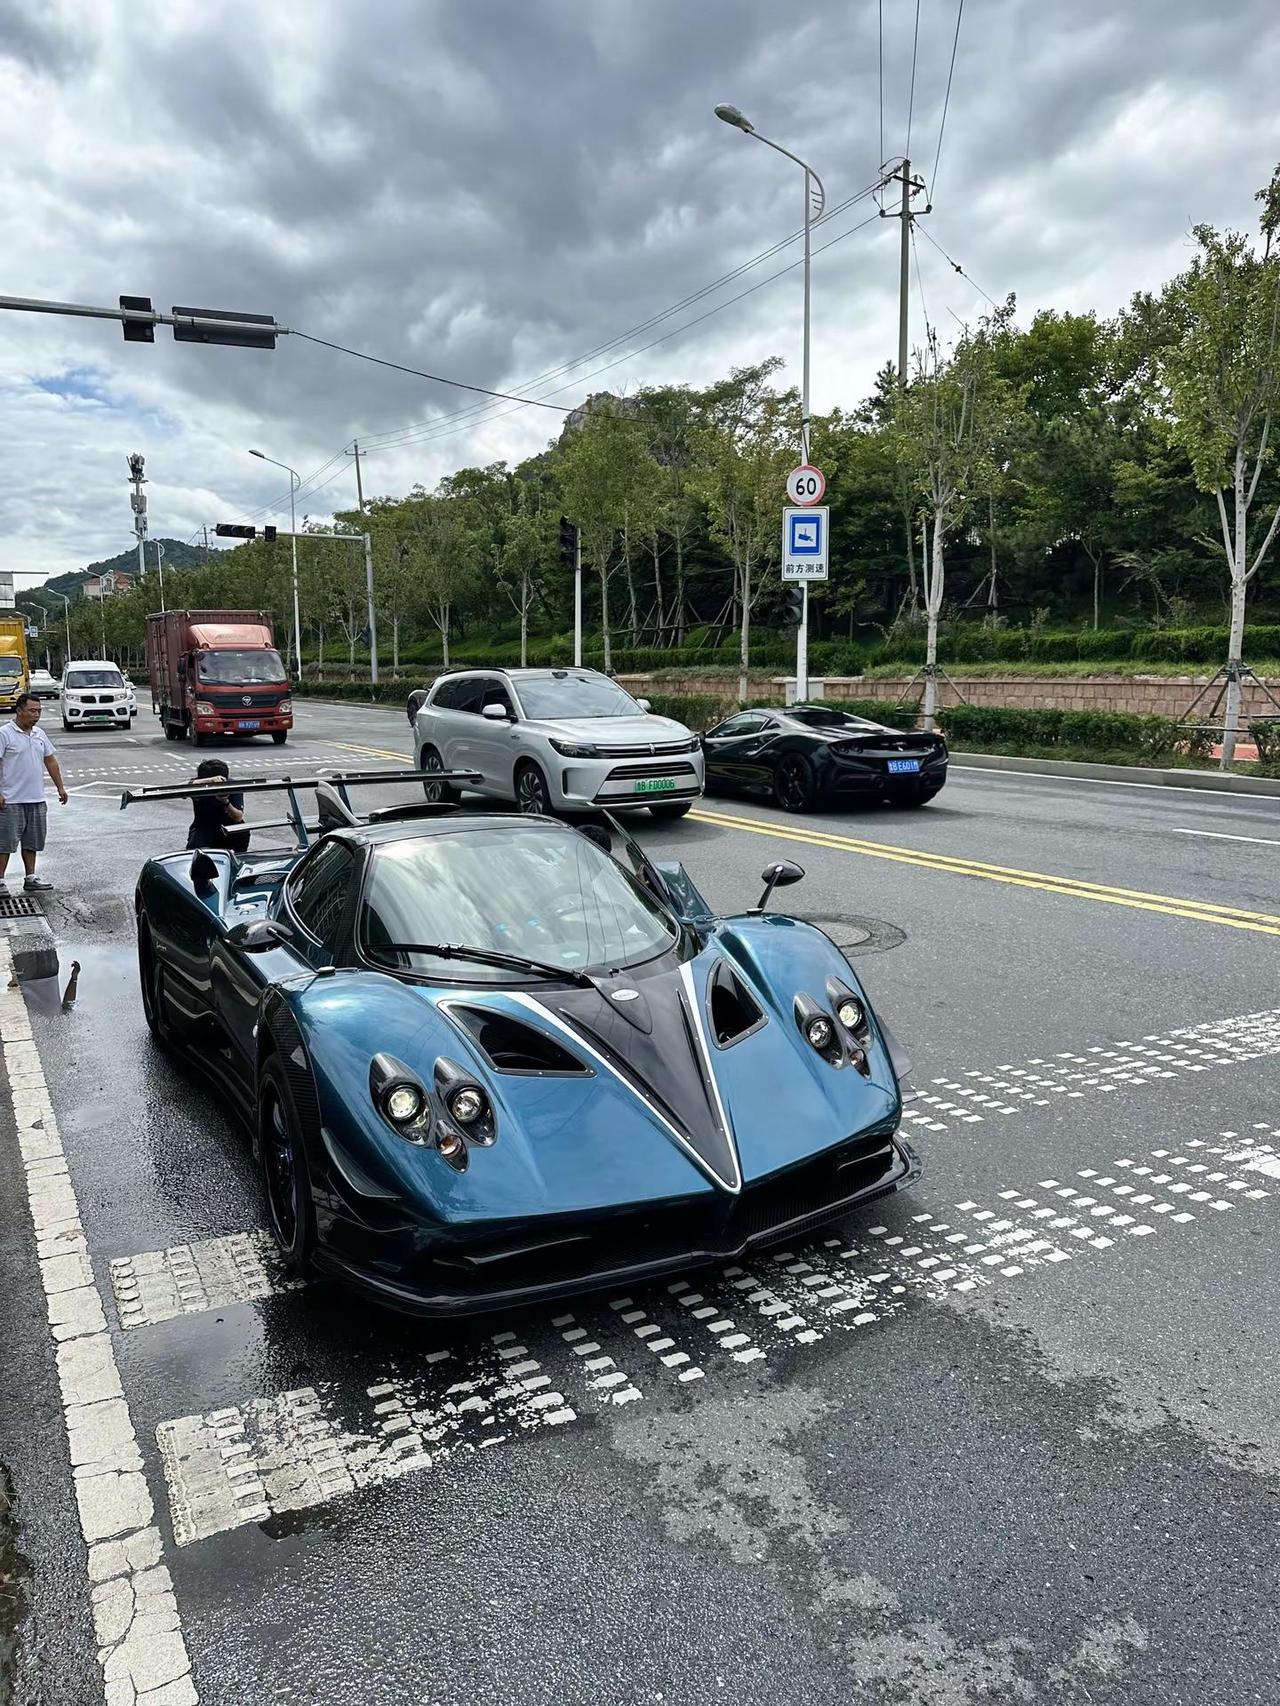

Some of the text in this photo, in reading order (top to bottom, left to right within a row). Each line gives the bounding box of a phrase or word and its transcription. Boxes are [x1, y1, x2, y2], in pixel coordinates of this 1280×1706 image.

[796, 478, 817, 495] 60
[786, 563, 824, 574] 前方测速
